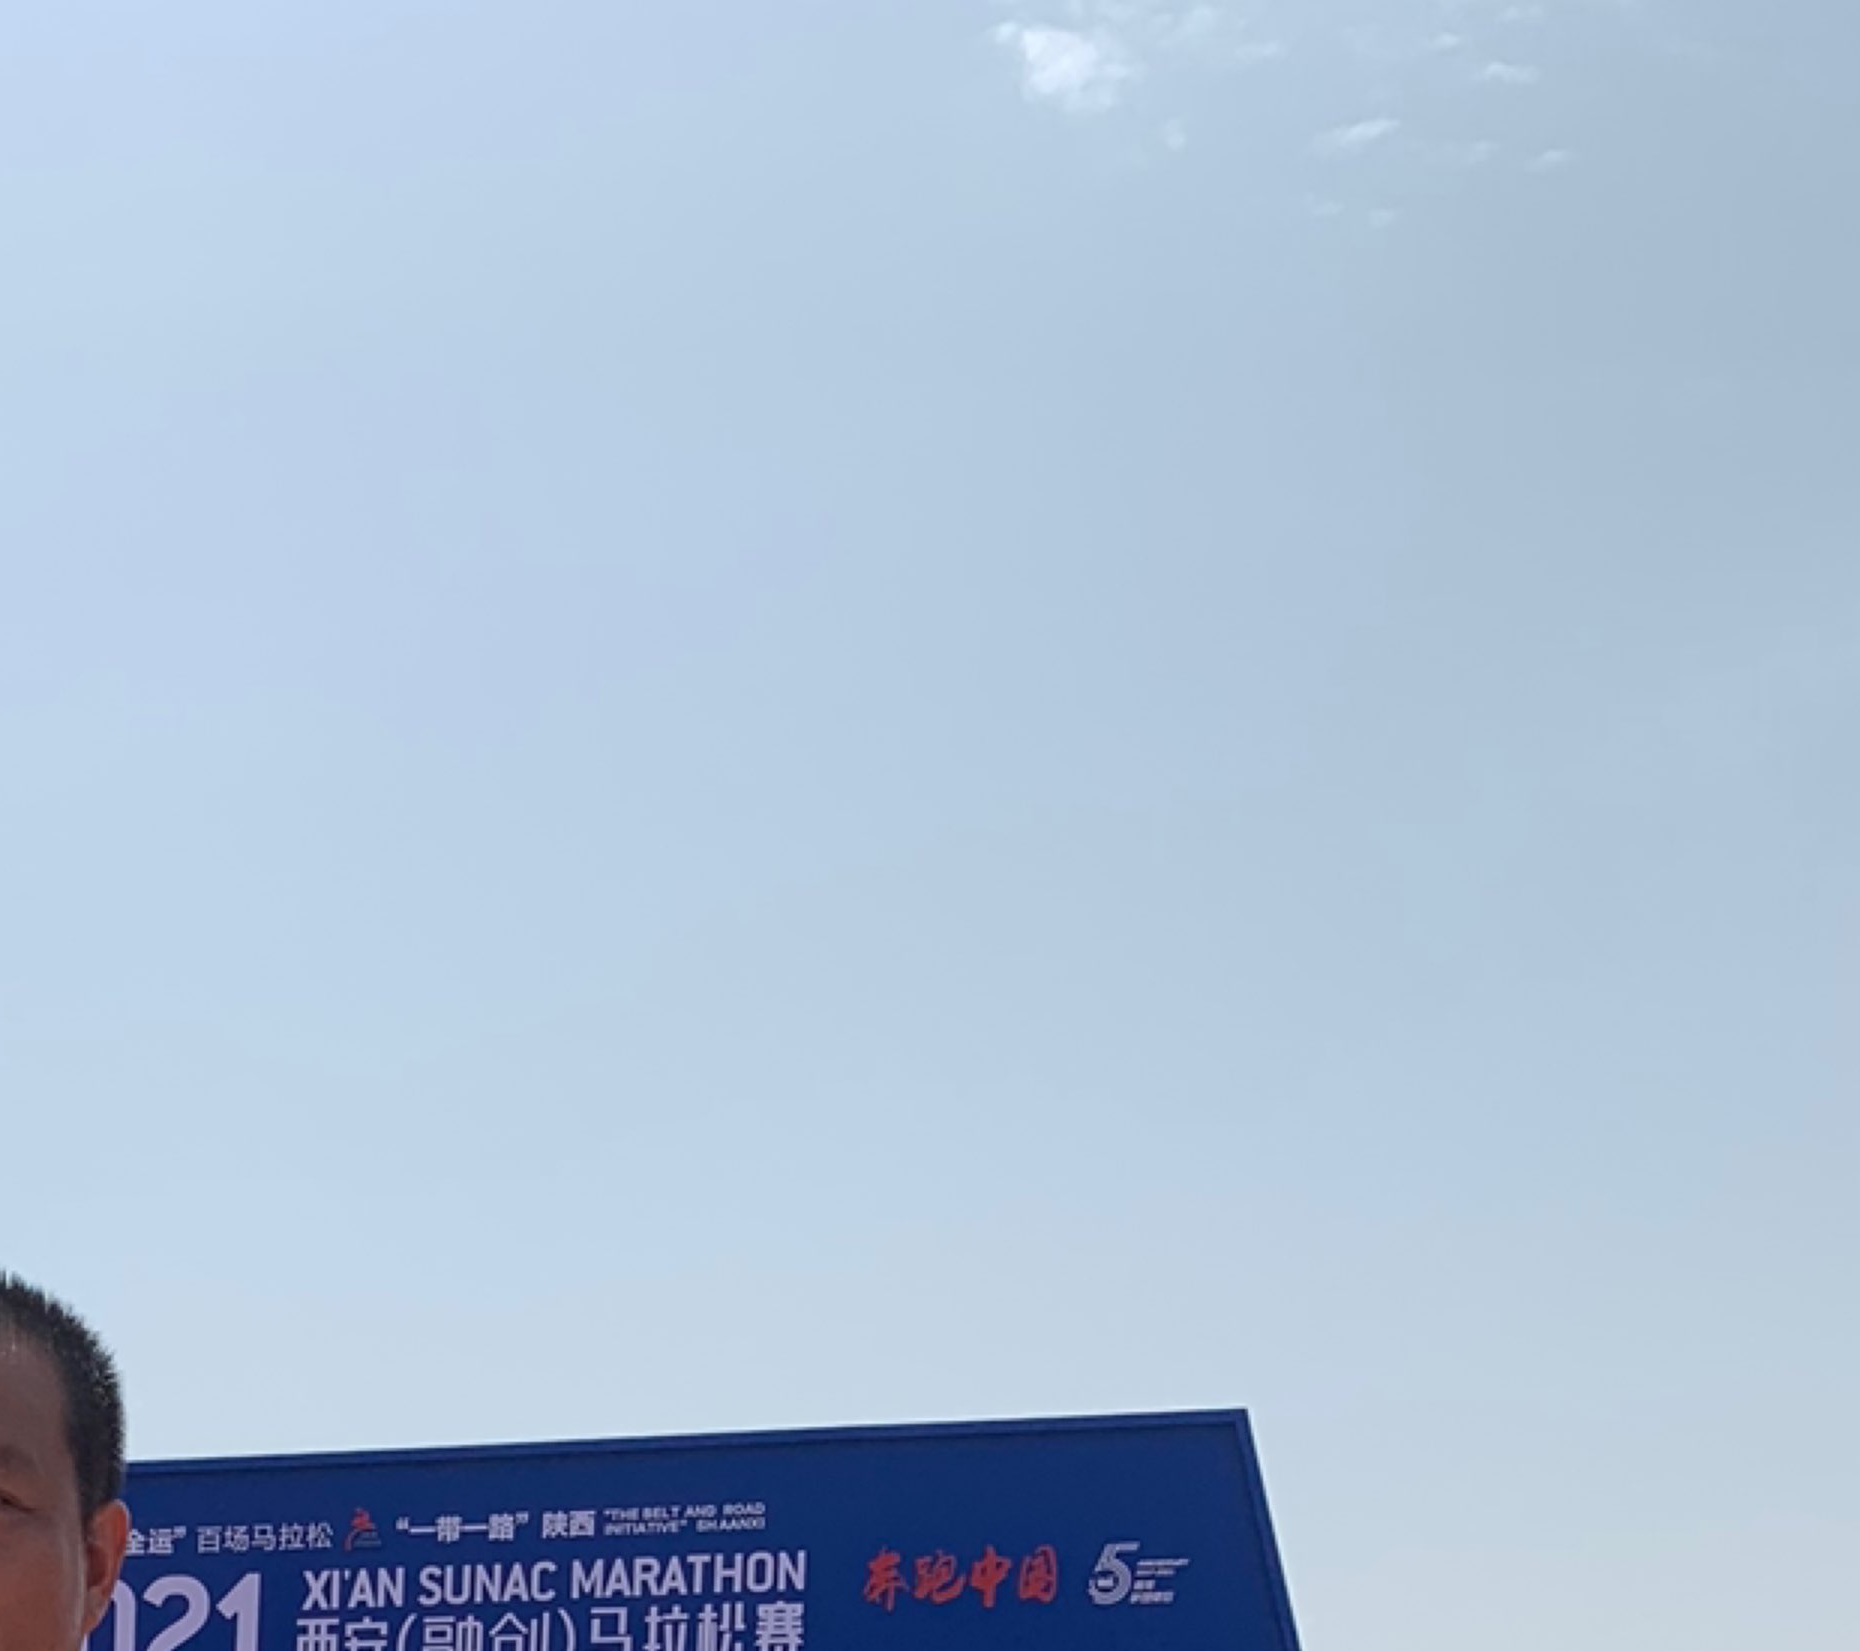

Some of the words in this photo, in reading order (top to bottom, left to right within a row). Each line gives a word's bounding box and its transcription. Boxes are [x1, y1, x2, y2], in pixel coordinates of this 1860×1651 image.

[542, 1510, 597, 1539] 陕西
[642, 1506, 680, 1521] BELT
[684, 1504, 717, 1518] AND
[722, 1502, 766, 1517] ROAD
[696, 1516, 766, 1533] SHAANXI
[196, 1520, 334, 1554] 百场马拉松
[302, 1566, 406, 1611] XI'AN
[417, 1560, 559, 1606] SUNAC
[570, 1549, 807, 1599] MARATHON
[862, 1543, 1060, 1612] 奔跑中国
